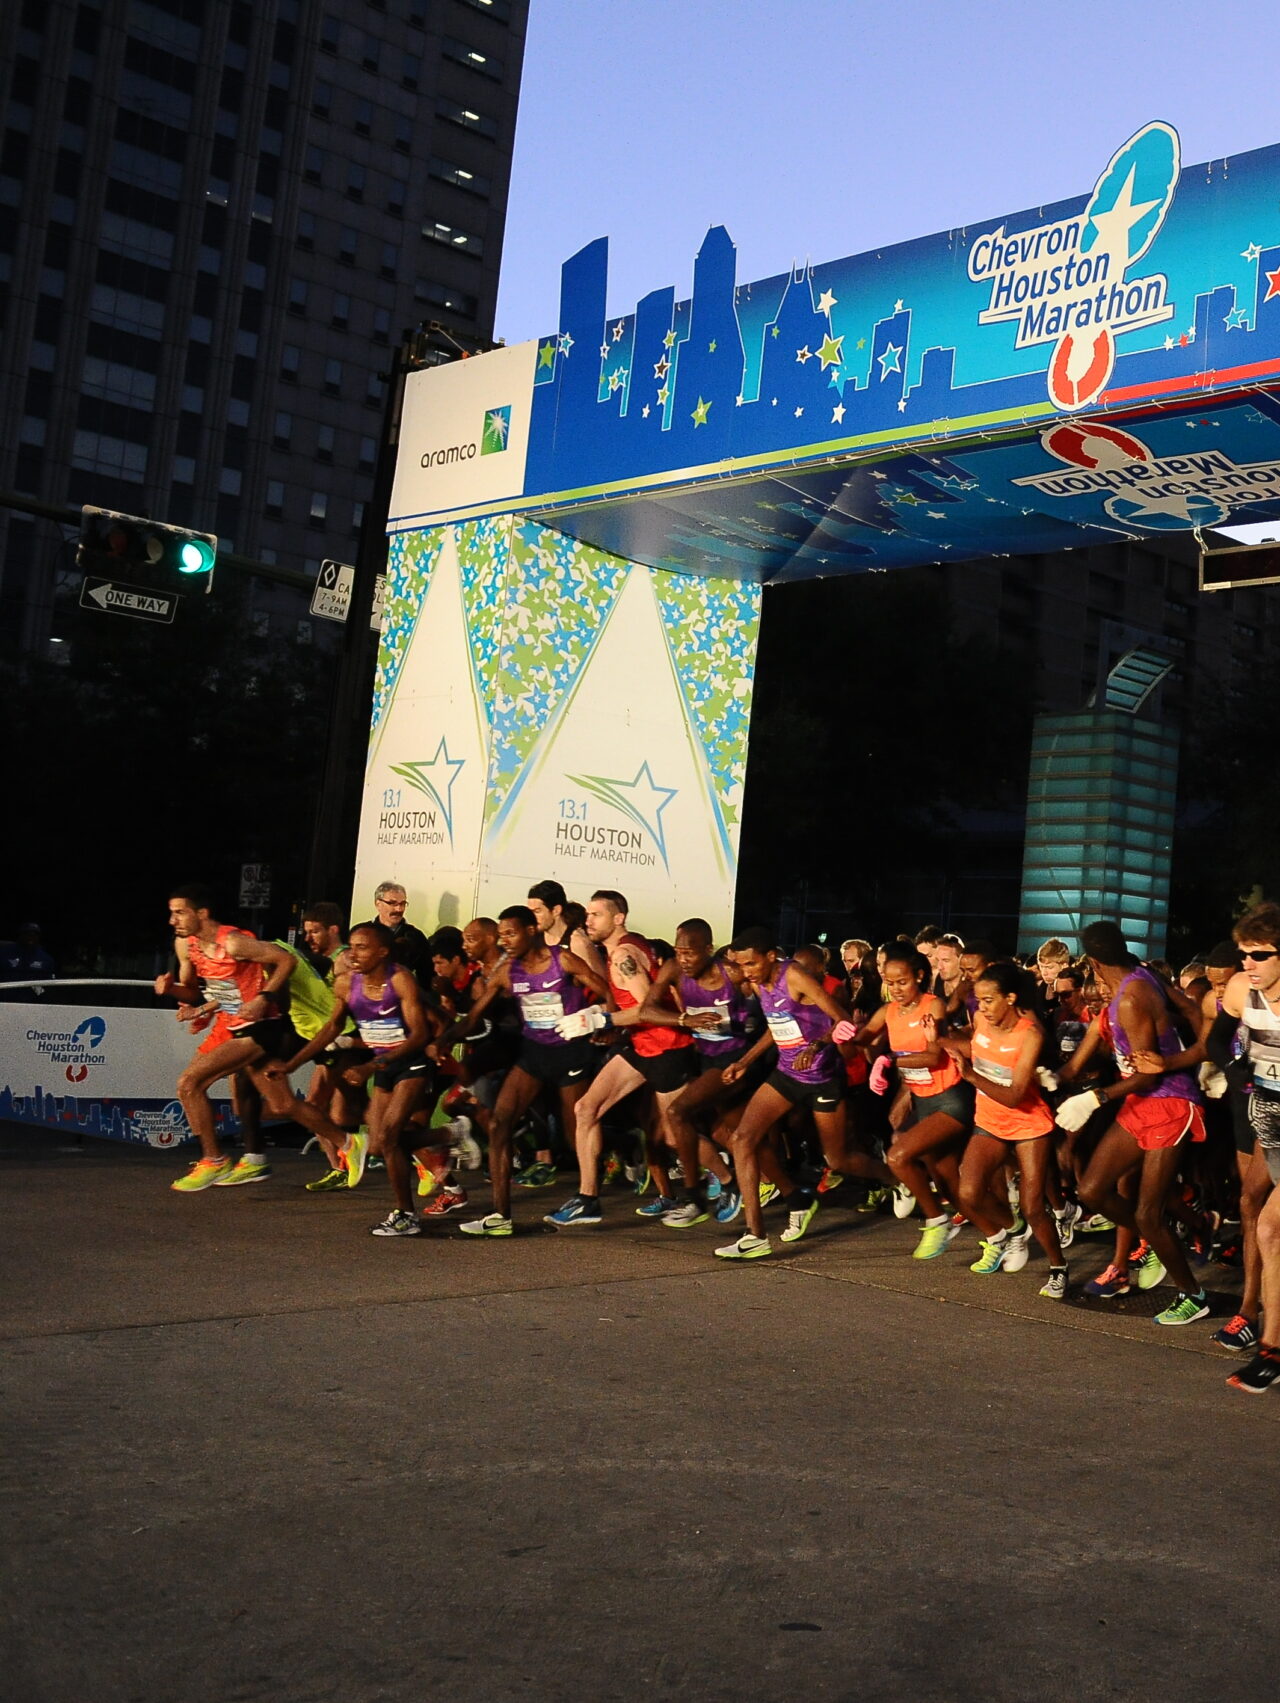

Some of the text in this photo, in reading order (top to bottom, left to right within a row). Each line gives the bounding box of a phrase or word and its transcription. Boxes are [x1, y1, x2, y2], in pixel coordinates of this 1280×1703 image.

[971, 221, 1080, 276] Chevron
[993, 252, 1110, 310] Houston
[1021, 280, 1161, 342] Marathon
[420, 443, 477, 468] aramco
[1038, 454, 1235, 495] Marathon
[105, 590, 166, 612] ONE WAY
[383, 788, 401, 808] 13.1
[559, 798, 588, 820] 13.1
[379, 811, 436, 829] HOUSTON
[377, 831, 444, 845] HALF MARATHON
[556, 822, 642, 849] HOUSTON
[555, 843, 655, 866] HALF MARATHON
[26, 1030, 71, 1041] Chevron
[38, 1041, 84, 1053] Houston
[51, 1052, 105, 1063] Marathon
